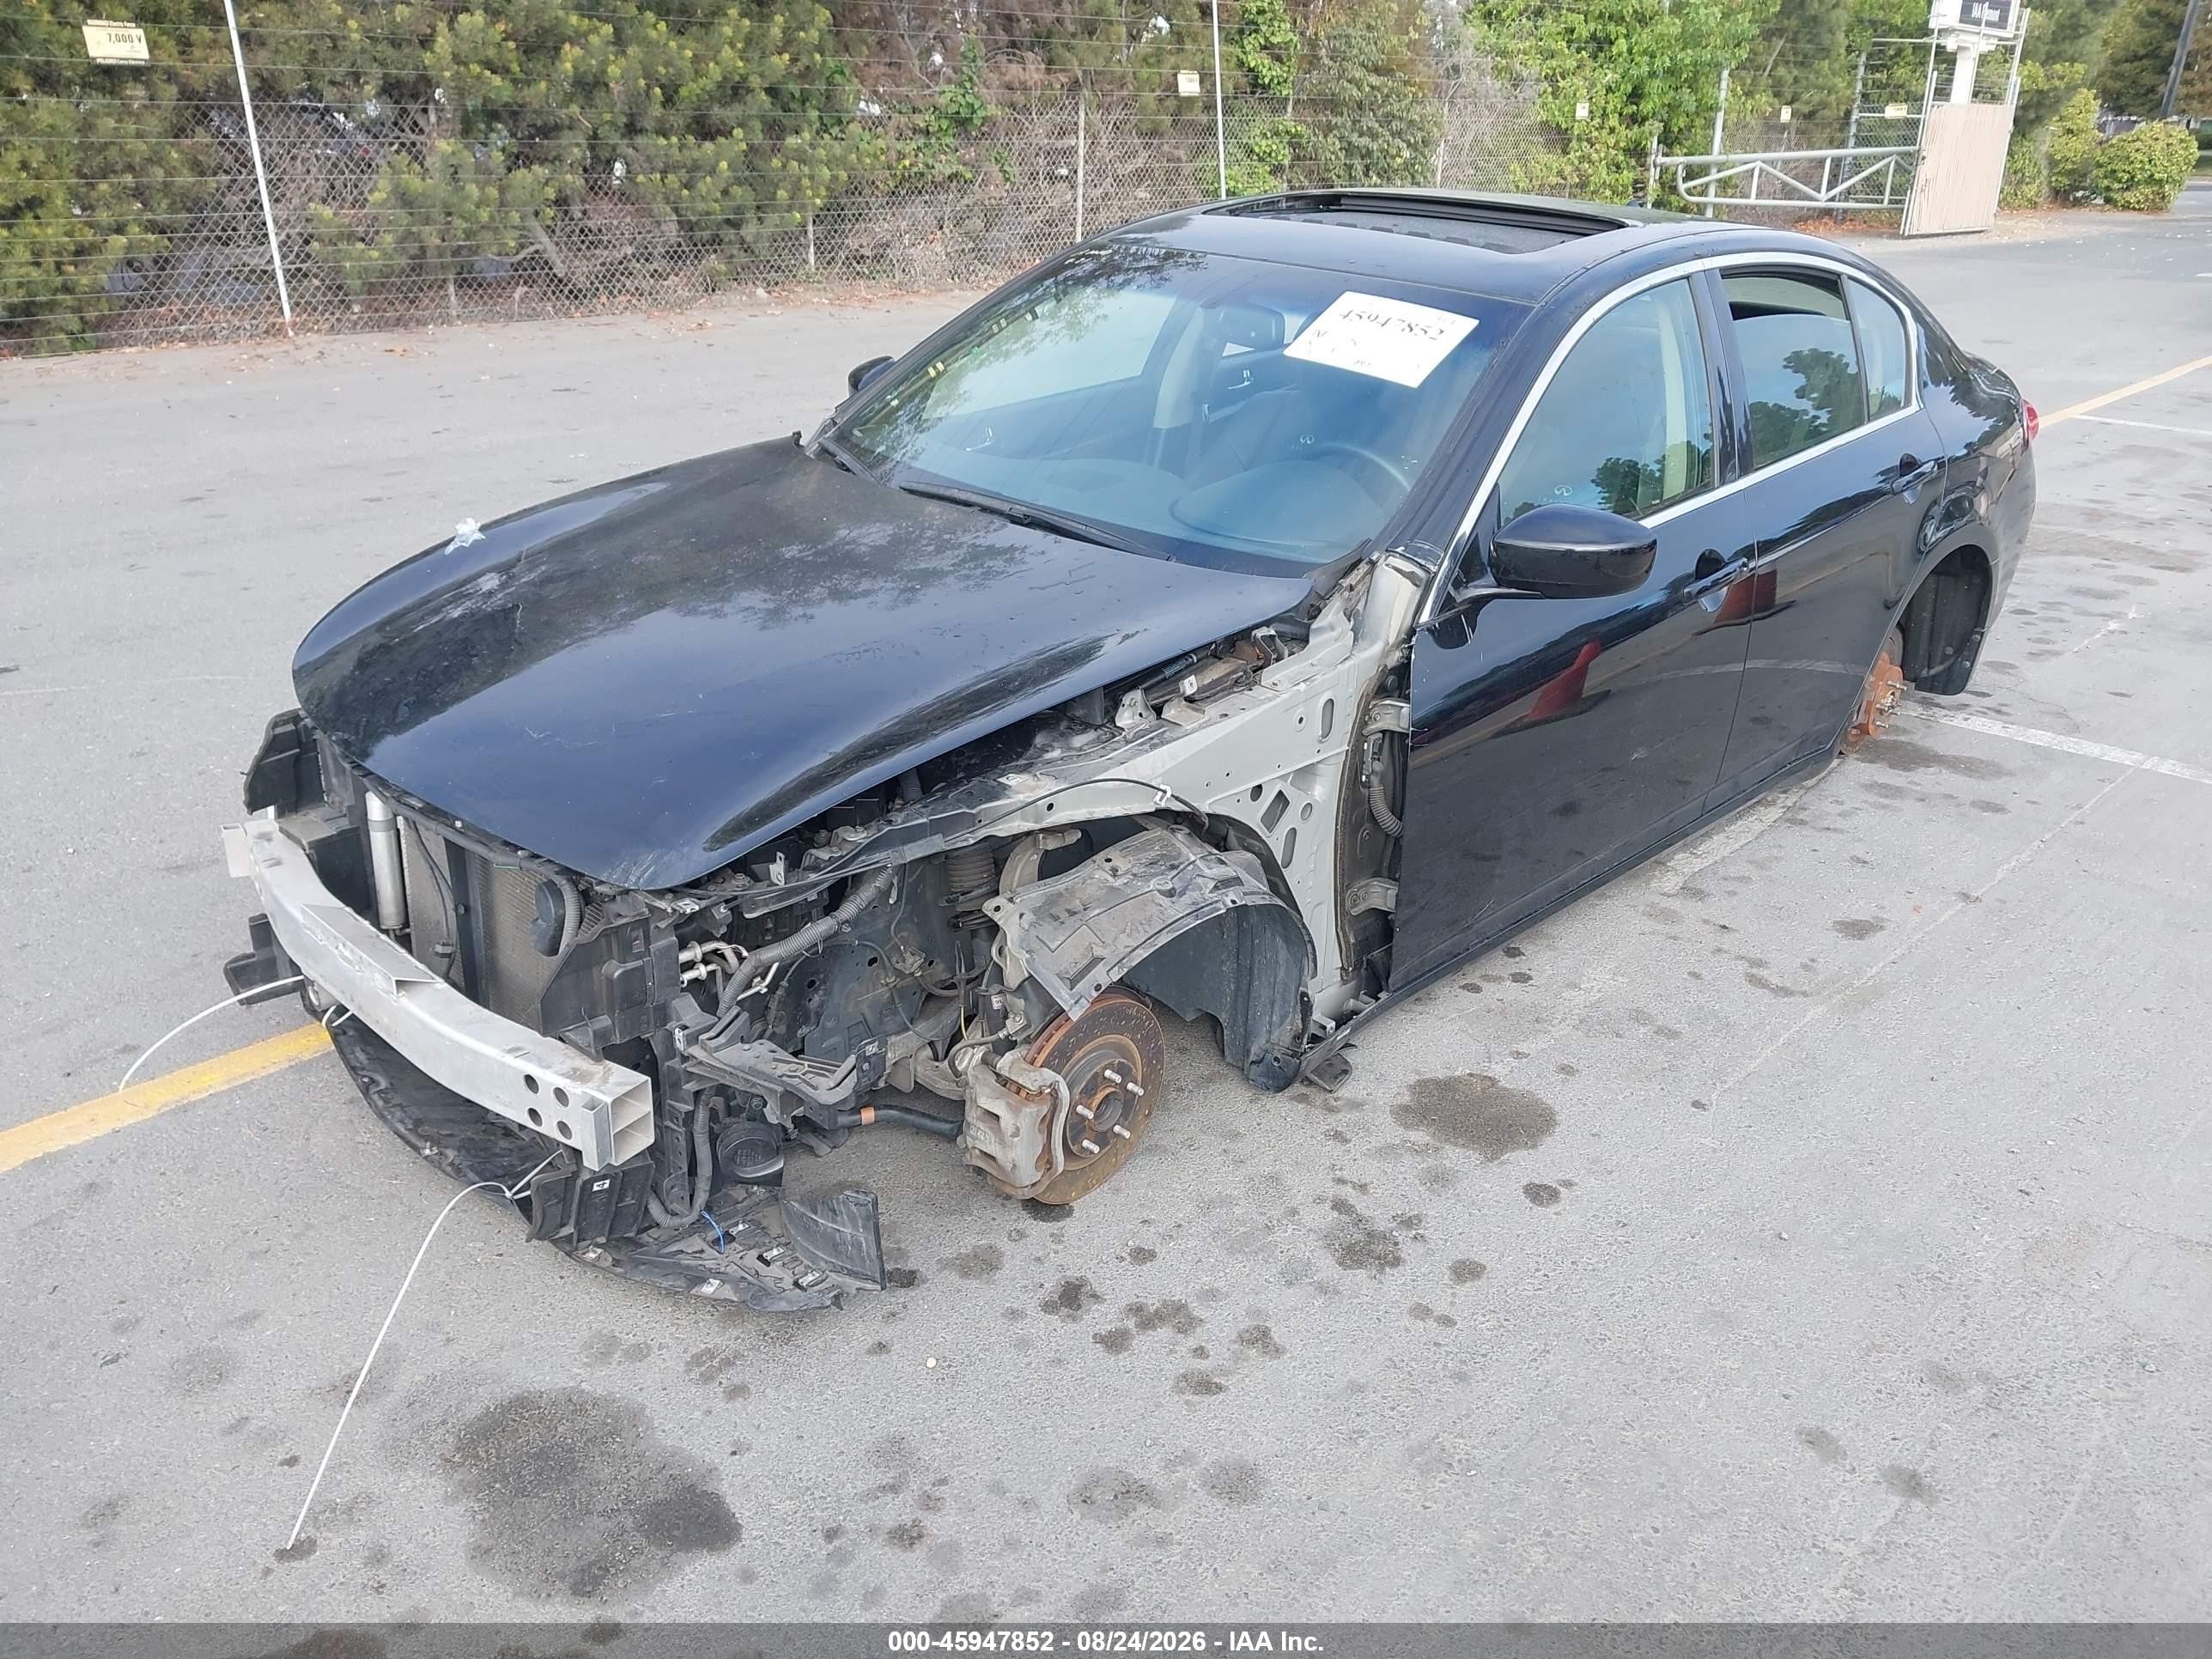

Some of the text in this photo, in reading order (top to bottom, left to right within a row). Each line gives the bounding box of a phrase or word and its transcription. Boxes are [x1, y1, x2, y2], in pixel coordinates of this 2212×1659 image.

[106, 33, 142, 44] 7,000 V
[1340, 309, 1445, 341] 45947852
